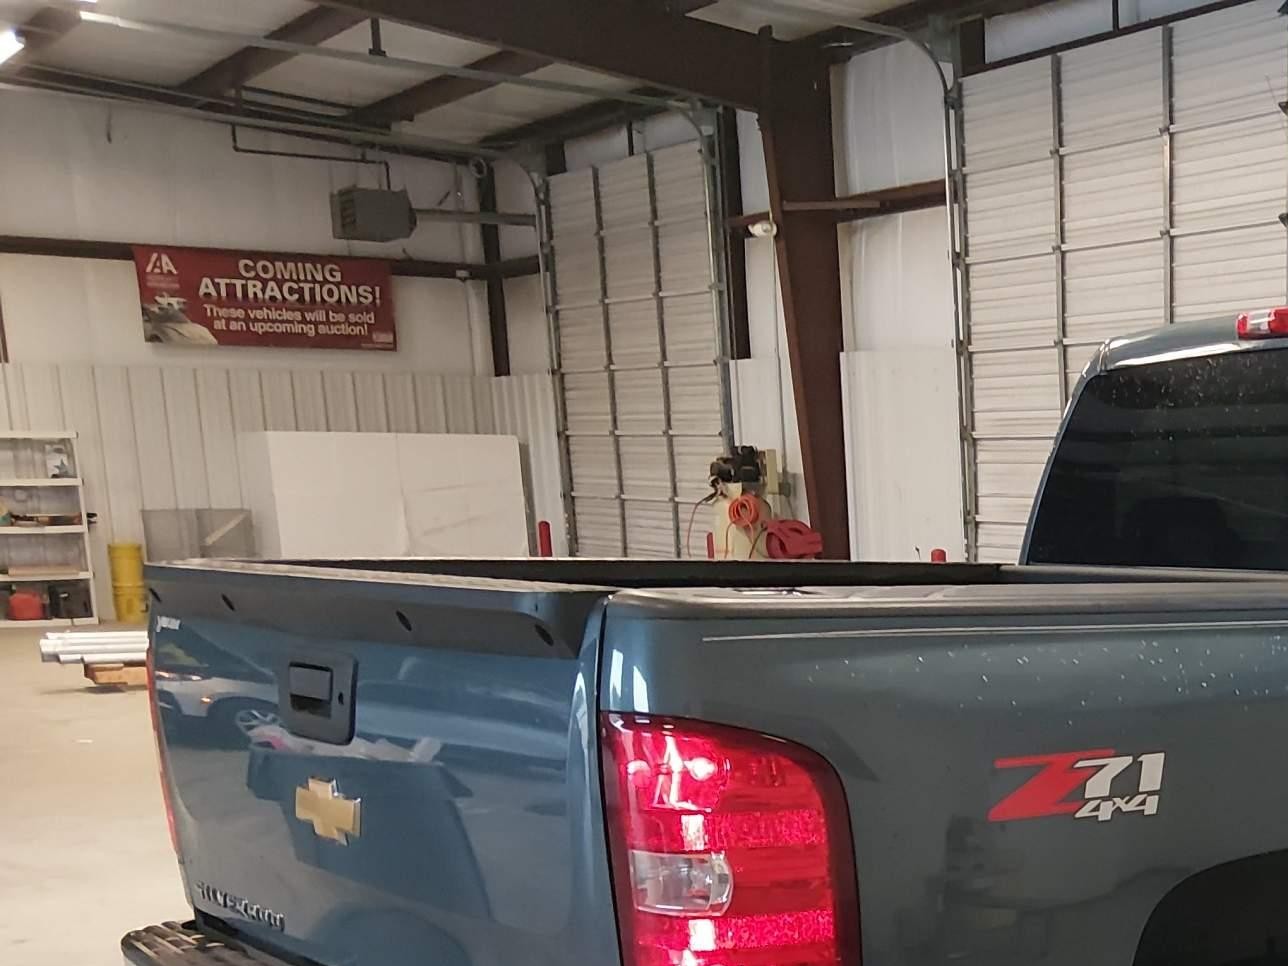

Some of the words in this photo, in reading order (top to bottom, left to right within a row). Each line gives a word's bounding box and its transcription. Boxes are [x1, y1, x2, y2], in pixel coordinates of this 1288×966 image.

[238, 259, 342, 282] COMING
[199, 277, 380, 306] ATTRACTIONS!
[203, 303, 245, 319] These
[248, 307, 302, 321] vehicles
[305, 310, 326, 321] will
[329, 310, 346, 322] be
[348, 312, 375, 324] sold
[213, 319, 226, 330] at
[229, 320, 246, 331] an
[249, 321, 315, 337] upcoming
[318, 323, 368, 336] auction!
[986, 748, 1165, 822] Z71
